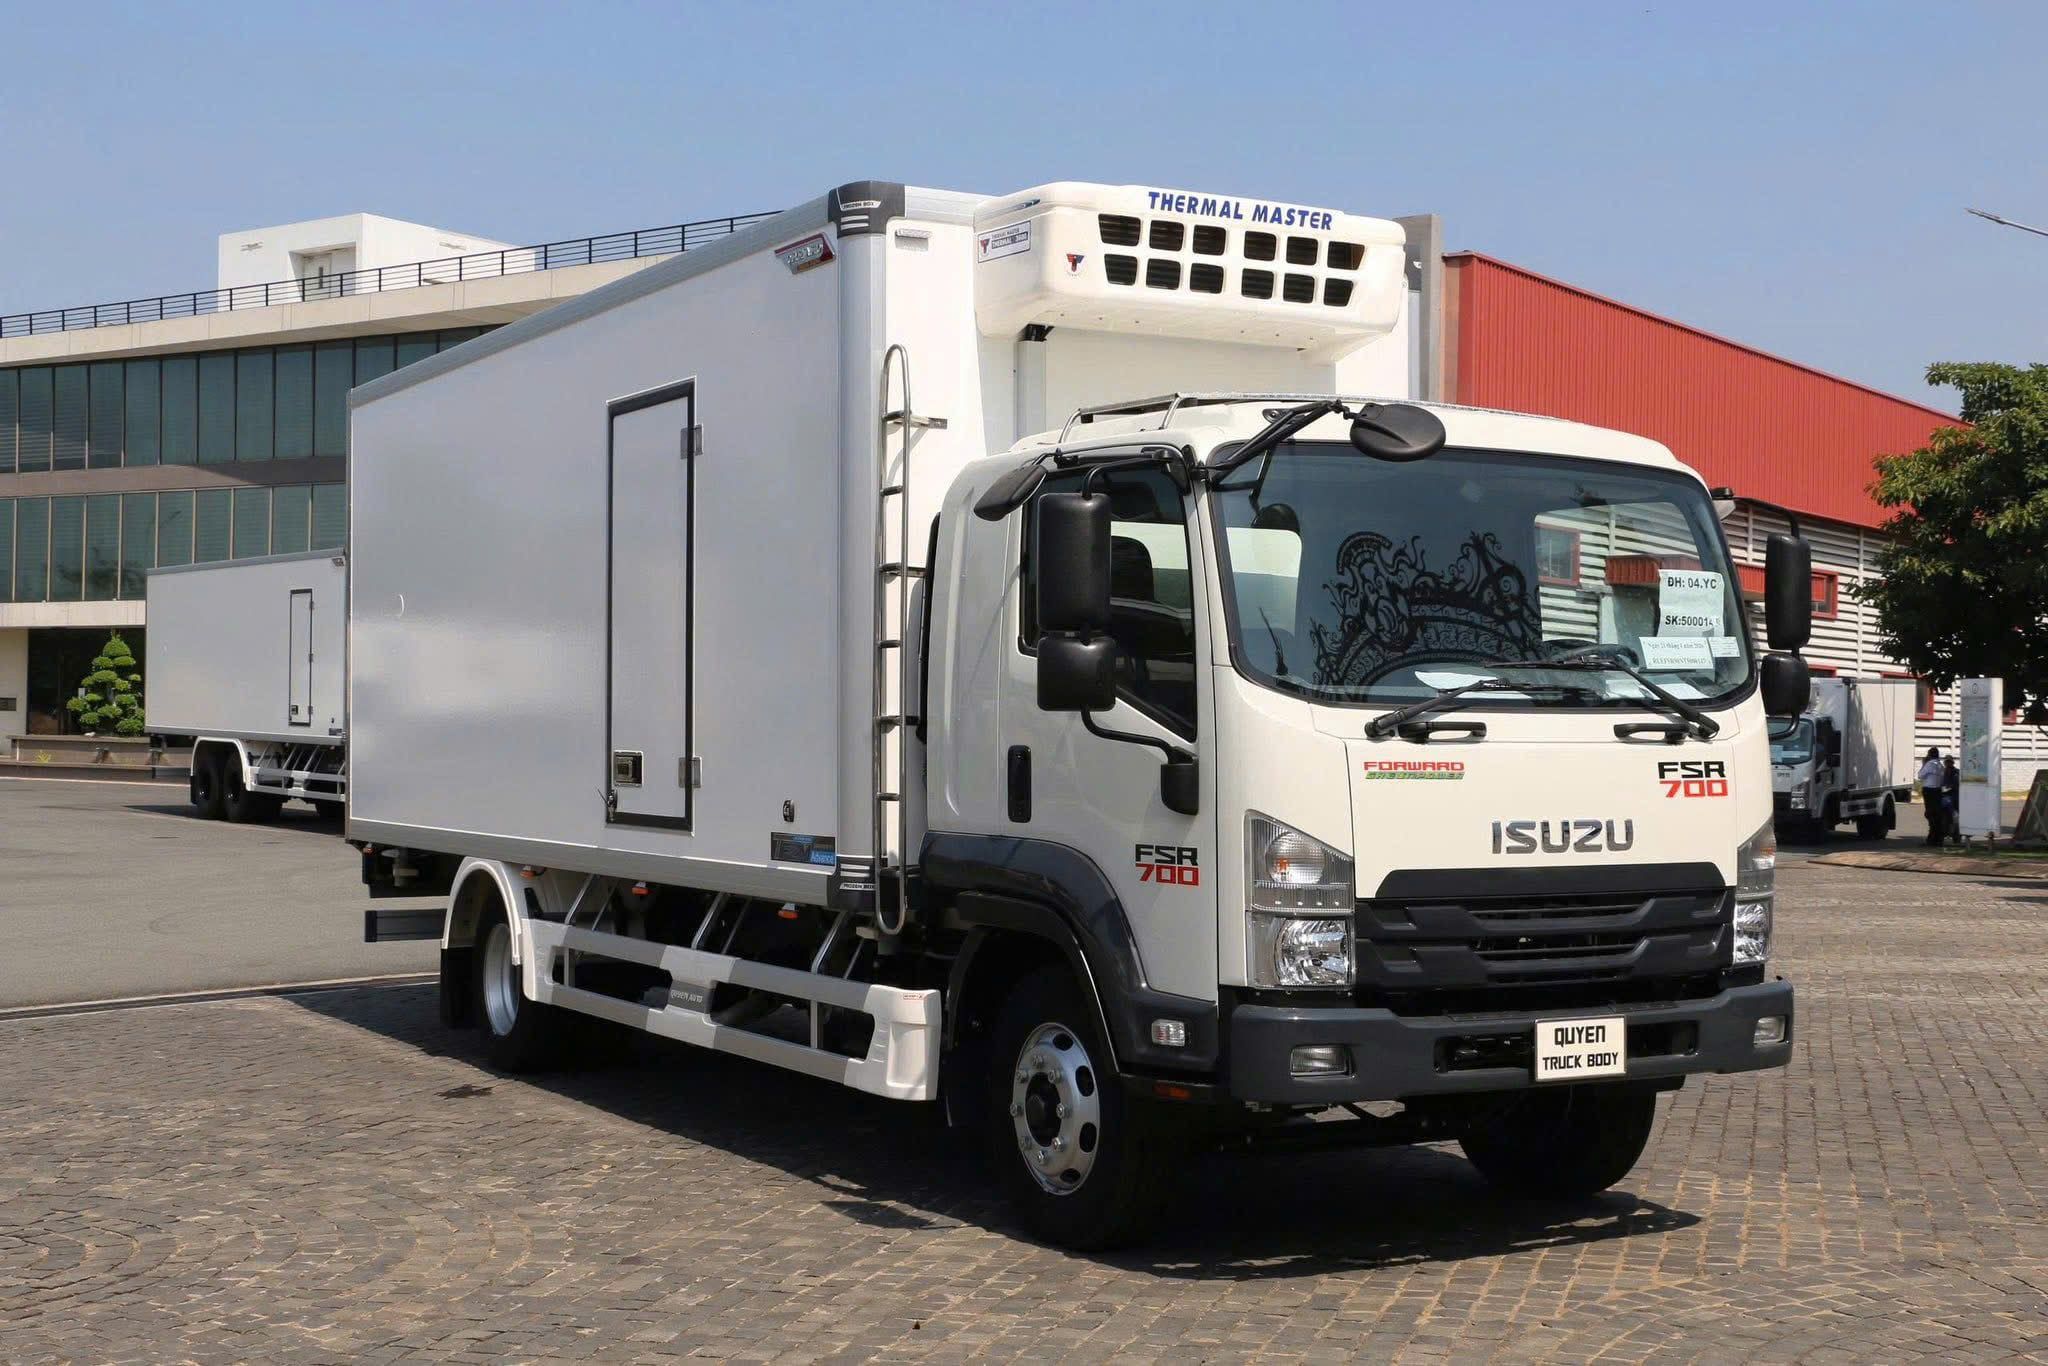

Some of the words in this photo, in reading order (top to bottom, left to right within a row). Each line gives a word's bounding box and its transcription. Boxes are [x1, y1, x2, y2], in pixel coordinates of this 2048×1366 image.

[1148, 191, 1243, 220] THERMAL
[1251, 204, 1332, 230] MASTER
[1687, 577, 1717, 589] 04.YC
[1363, 761, 1464, 771] FORWARD
[1658, 761, 1726, 779] FSR
[1659, 779, 1728, 798] 700
[1492, 819, 1634, 854] ISUZU
[1135, 844, 1199, 866] FSR
[1135, 863, 1200, 886] 700
[1554, 1025, 1606, 1048] QUYEN
[1542, 1055, 1582, 1070] TRUCK
[1587, 1052, 1618, 1067] BODY
